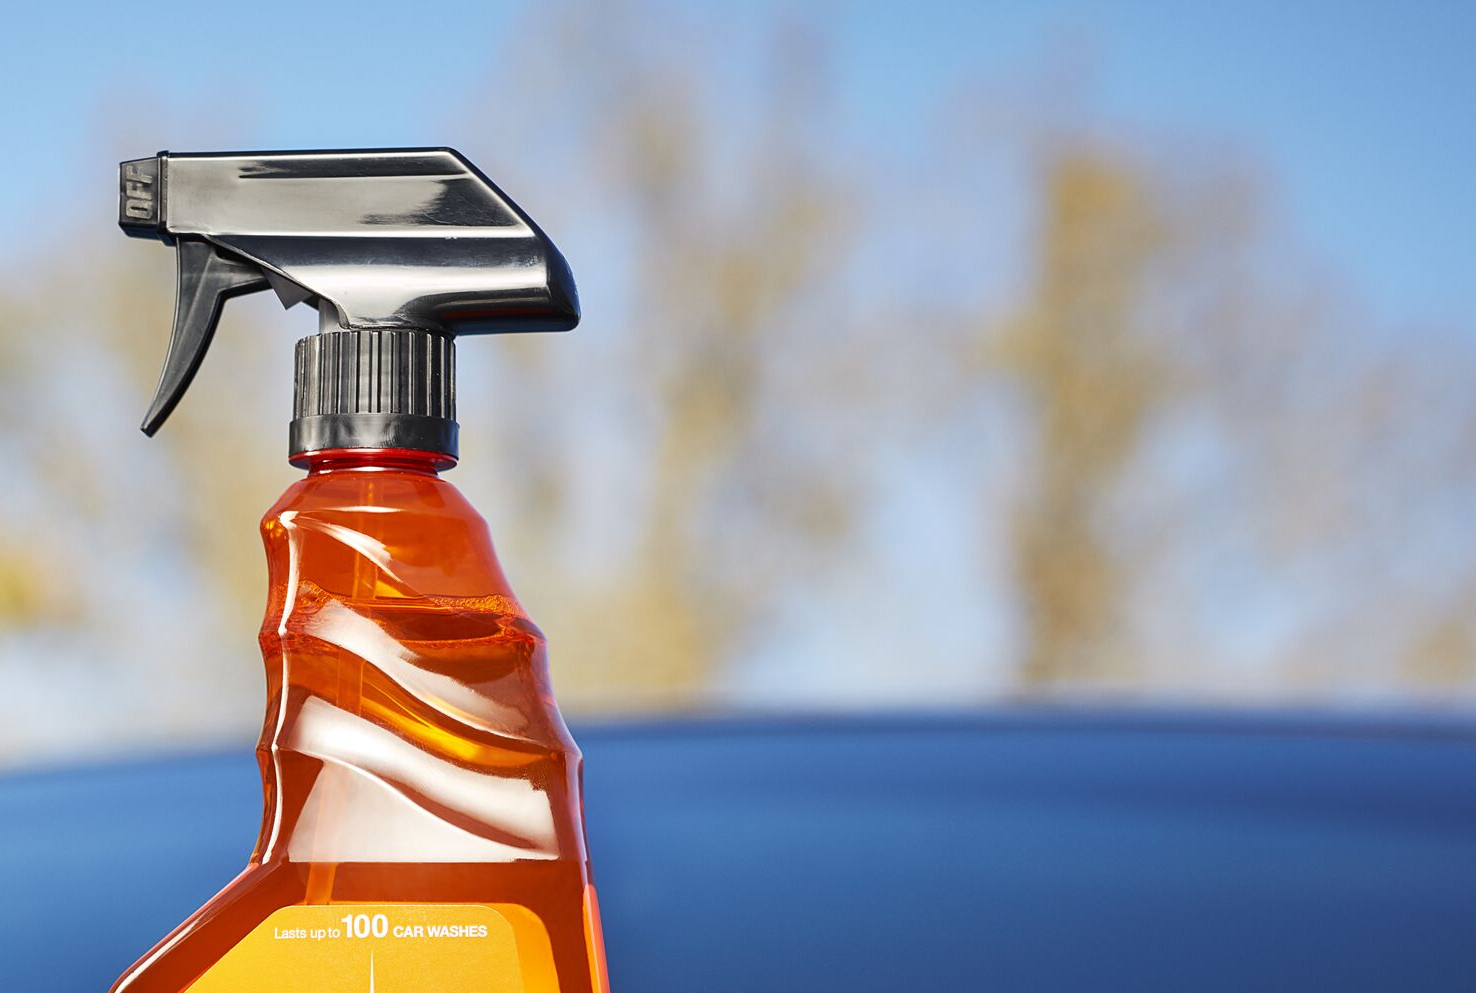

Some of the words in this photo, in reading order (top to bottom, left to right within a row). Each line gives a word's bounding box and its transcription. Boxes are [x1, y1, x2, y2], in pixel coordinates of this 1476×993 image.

[125, 165, 153, 220] OFF
[274, 928, 307, 939] Lasts
[310, 929, 326, 940] up
[327, 928, 340, 939] to
[341, 914, 389, 939] 100
[393, 926, 424, 938] CAR
[428, 925, 488, 938] WASHES
